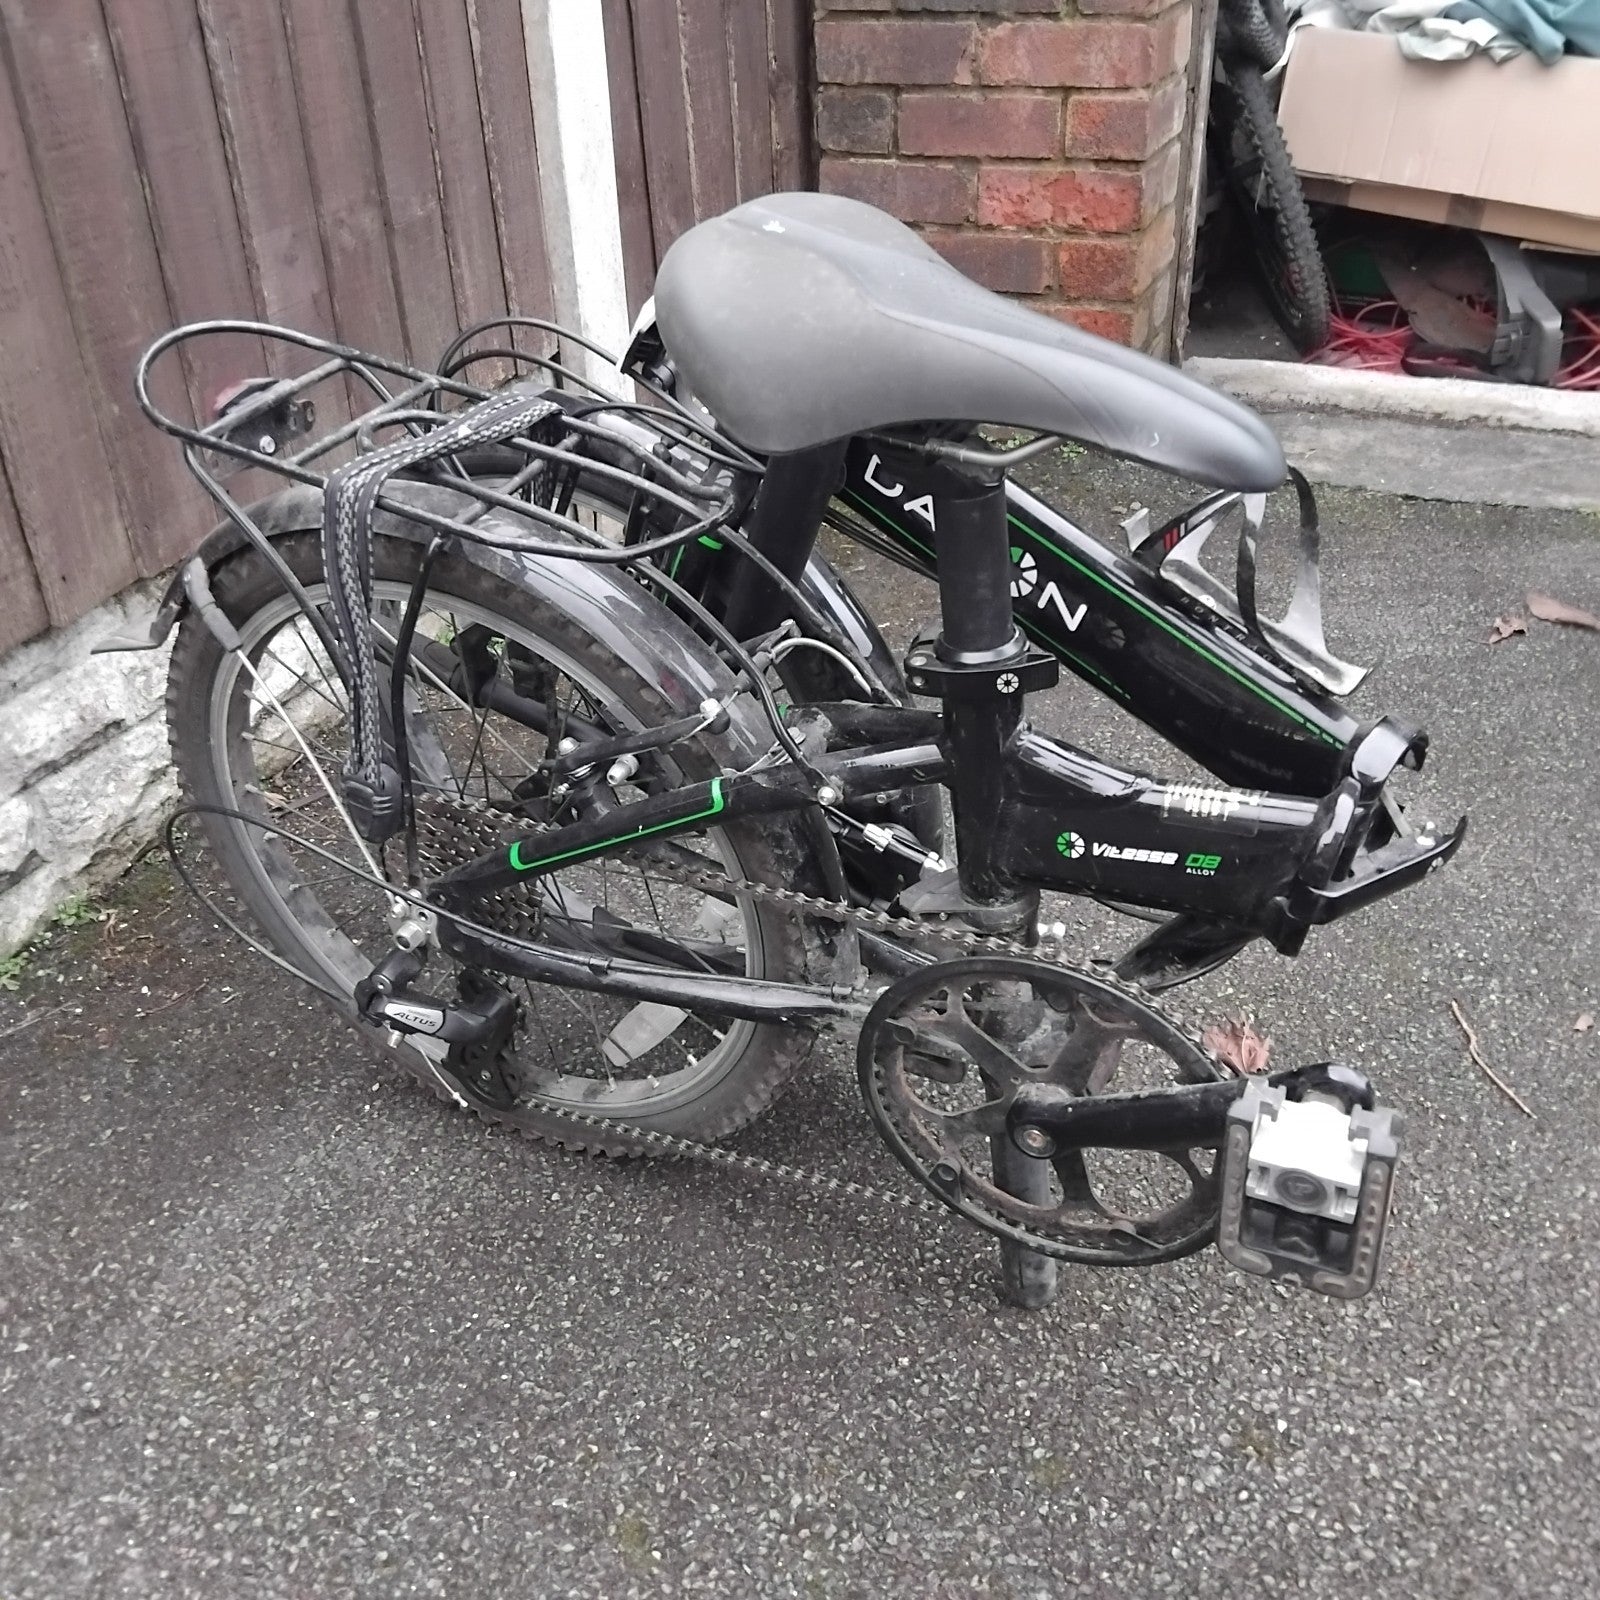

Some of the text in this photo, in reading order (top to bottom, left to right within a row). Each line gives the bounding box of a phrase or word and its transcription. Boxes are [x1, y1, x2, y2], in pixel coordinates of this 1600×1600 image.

[1092, 842, 1179, 865] Vitesse
[1185, 867, 1216, 877] ALLOY
[393, 1012, 437, 1027] ALTUS
